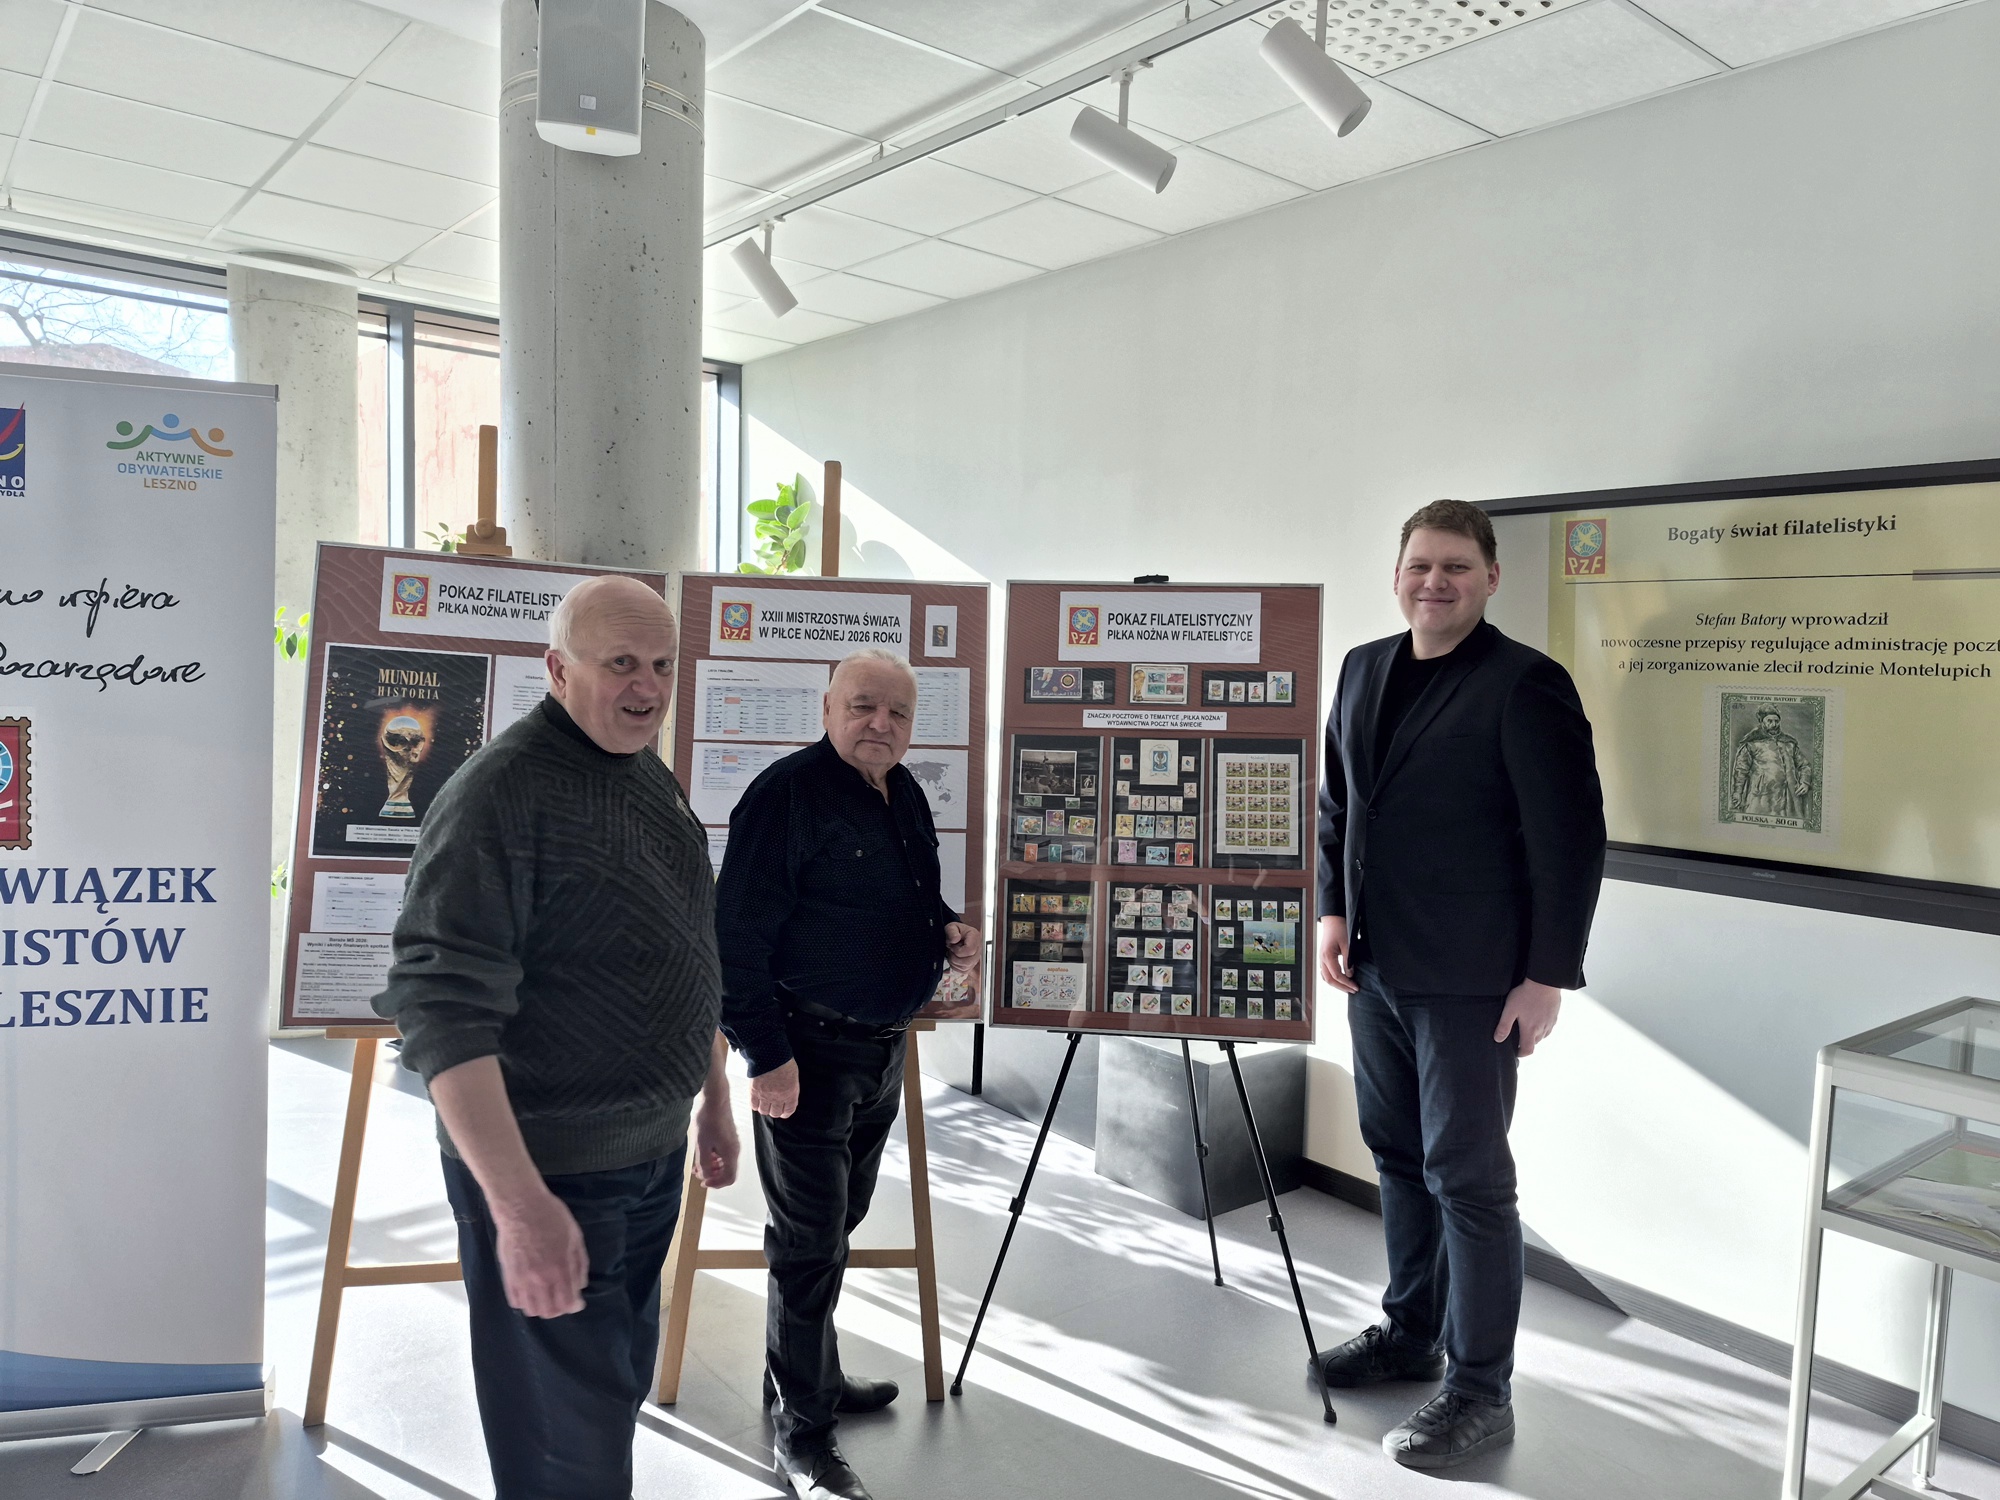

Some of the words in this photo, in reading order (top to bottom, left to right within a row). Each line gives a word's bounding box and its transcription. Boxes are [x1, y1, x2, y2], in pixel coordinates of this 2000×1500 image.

[136, 450, 204, 465] AKTYWNE
[118, 463, 222, 480] OBYWATELSKIE
[144, 478, 197, 490] LESZNO
[1668, 525, 1725, 544] Bogaty
[1730, 522, 1778, 539] świat
[1783, 515, 1897, 536] filatelistyki
[1568, 556, 1603, 574] PZF
[439, 584, 484, 601] POKAZ
[395, 602, 425, 616] PZF
[438, 602, 469, 614] PIŁKA
[472, 604, 508, 618] NOŻNA
[510, 608, 520, 618] W
[761, 610, 784, 622] XXIII
[786, 612, 861, 626] MISTRZOSTWA
[862, 612, 900, 628] ŚWIATA
[1108, 613, 1147, 626] POKAZ
[1150, 613, 1254, 628] FILATELISTYCZNY
[1696, 613, 1736, 629] Stefan
[1740, 613, 1786, 630] Batory
[1791, 612, 1889, 628] wprowadził
[722, 627, 749, 640] PZF
[759, 626, 769, 638] W
[771, 627, 802, 640] PIŁCE
[804, 627, 845, 642] NOŻNEJ
[848, 630, 870, 642] 2026
[874, 632, 902, 644] ROKU
[1071, 632, 1096, 644] PZF
[1107, 630, 1134, 640] PIŁKA
[1136, 628, 1168, 641] NOŻNA
[1170, 630, 1180, 641] W
[1182, 630, 1253, 642] FILATELISTYCE
[1600, 637, 1681, 650] nowoczesne
[1685, 637, 1746, 652] przepisy
[1750, 637, 1830, 654] regulujące
[1834, 637, 1948, 654] administrację
[378, 668, 440, 687] MUNDIAL
[1618, 661, 1625, 670] a
[1628, 658, 1644, 673] jej
[1647, 658, 1759, 675] zorganizowanie
[1764, 660, 1804, 674] zlecił
[1808, 660, 1875, 676] rodzinie
[1879, 662, 1991, 681] Montelupich
[378, 686, 439, 700] HISTORIA
[1742, 816, 1768, 824] POLSKA
[2, 918, 186, 966] ISTÓW
